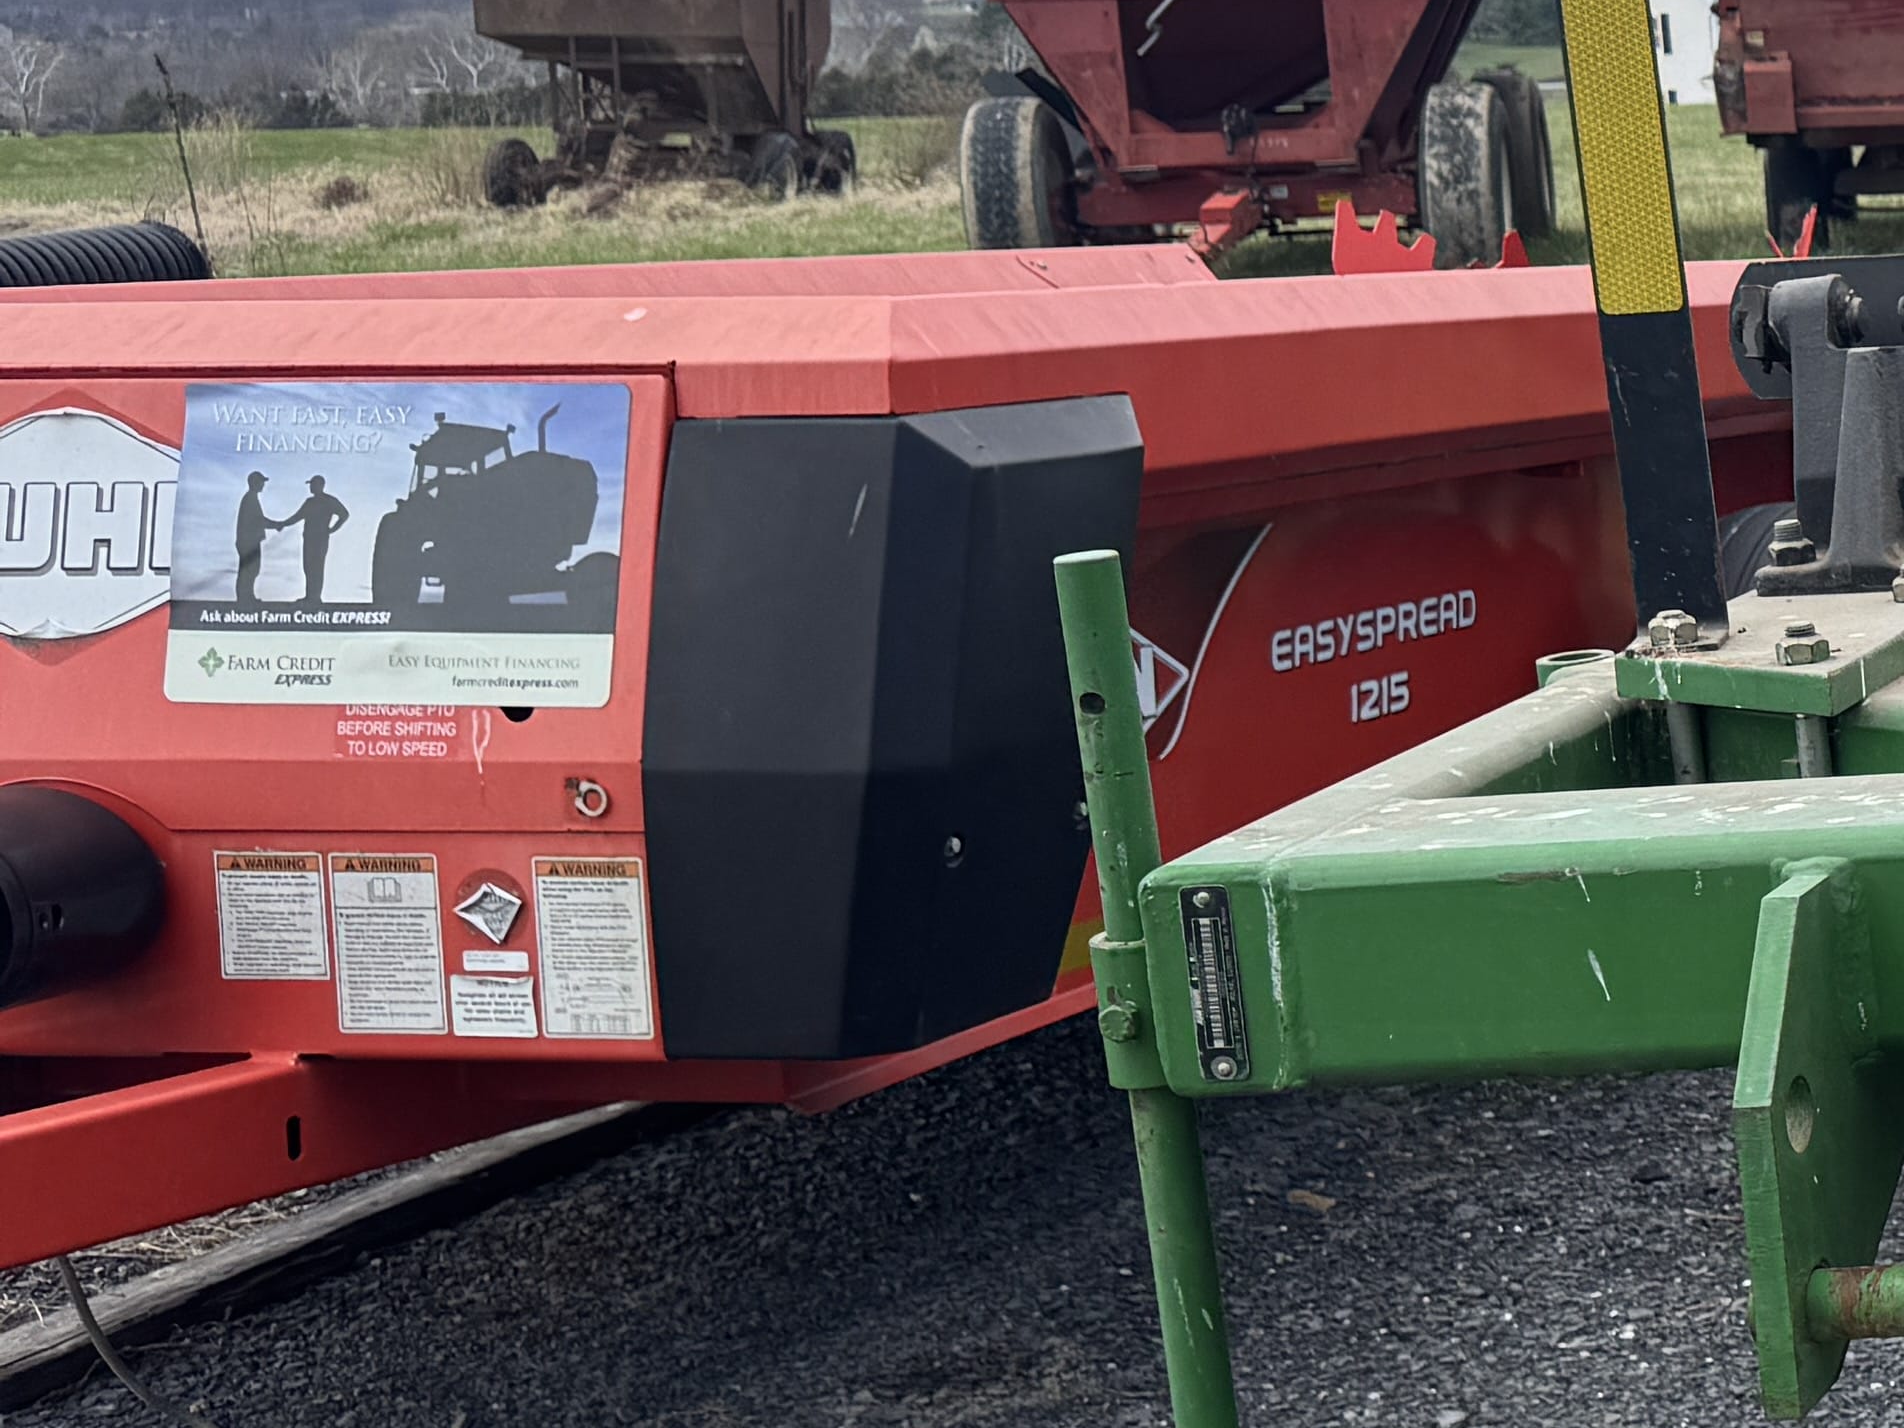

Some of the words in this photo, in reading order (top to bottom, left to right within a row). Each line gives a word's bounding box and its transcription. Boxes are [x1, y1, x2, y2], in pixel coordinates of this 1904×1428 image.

[213, 402, 284, 424] WANT
[292, 405, 348, 428] FAST,
[356, 405, 412, 425] EASY
[236, 431, 383, 453] FINANCING?
[200, 609, 222, 623] Ask
[223, 610, 258, 623] about
[261, 611, 291, 623] Farm
[294, 610, 330, 624] Credit
[331, 612, 392, 625] EXPRESS!
[1271, 589, 1477, 671] EASYSPREAD
[228, 655, 270, 671] FARM
[277, 655, 336, 671] CREDIT
[388, 655, 420, 669] EASY
[424, 655, 500, 670] EQUIPMENT
[505, 656, 581, 669] FINANCING
[275, 674, 333, 687] EXPRESS
[452, 676, 579, 690] farmcreditexpress.com
[1351, 671, 1410, 723] 1215
[337, 721, 392, 736] BEFORE
[395, 721, 457, 736] SHIFTING
[347, 741, 366, 756] TO
[368, 741, 400, 756] LOW
[402, 741, 447, 757] SPEED
[244, 859, 307, 870] WARNING
[359, 859, 421, 871] WARNING
[562, 862, 626, 876] WARNING
